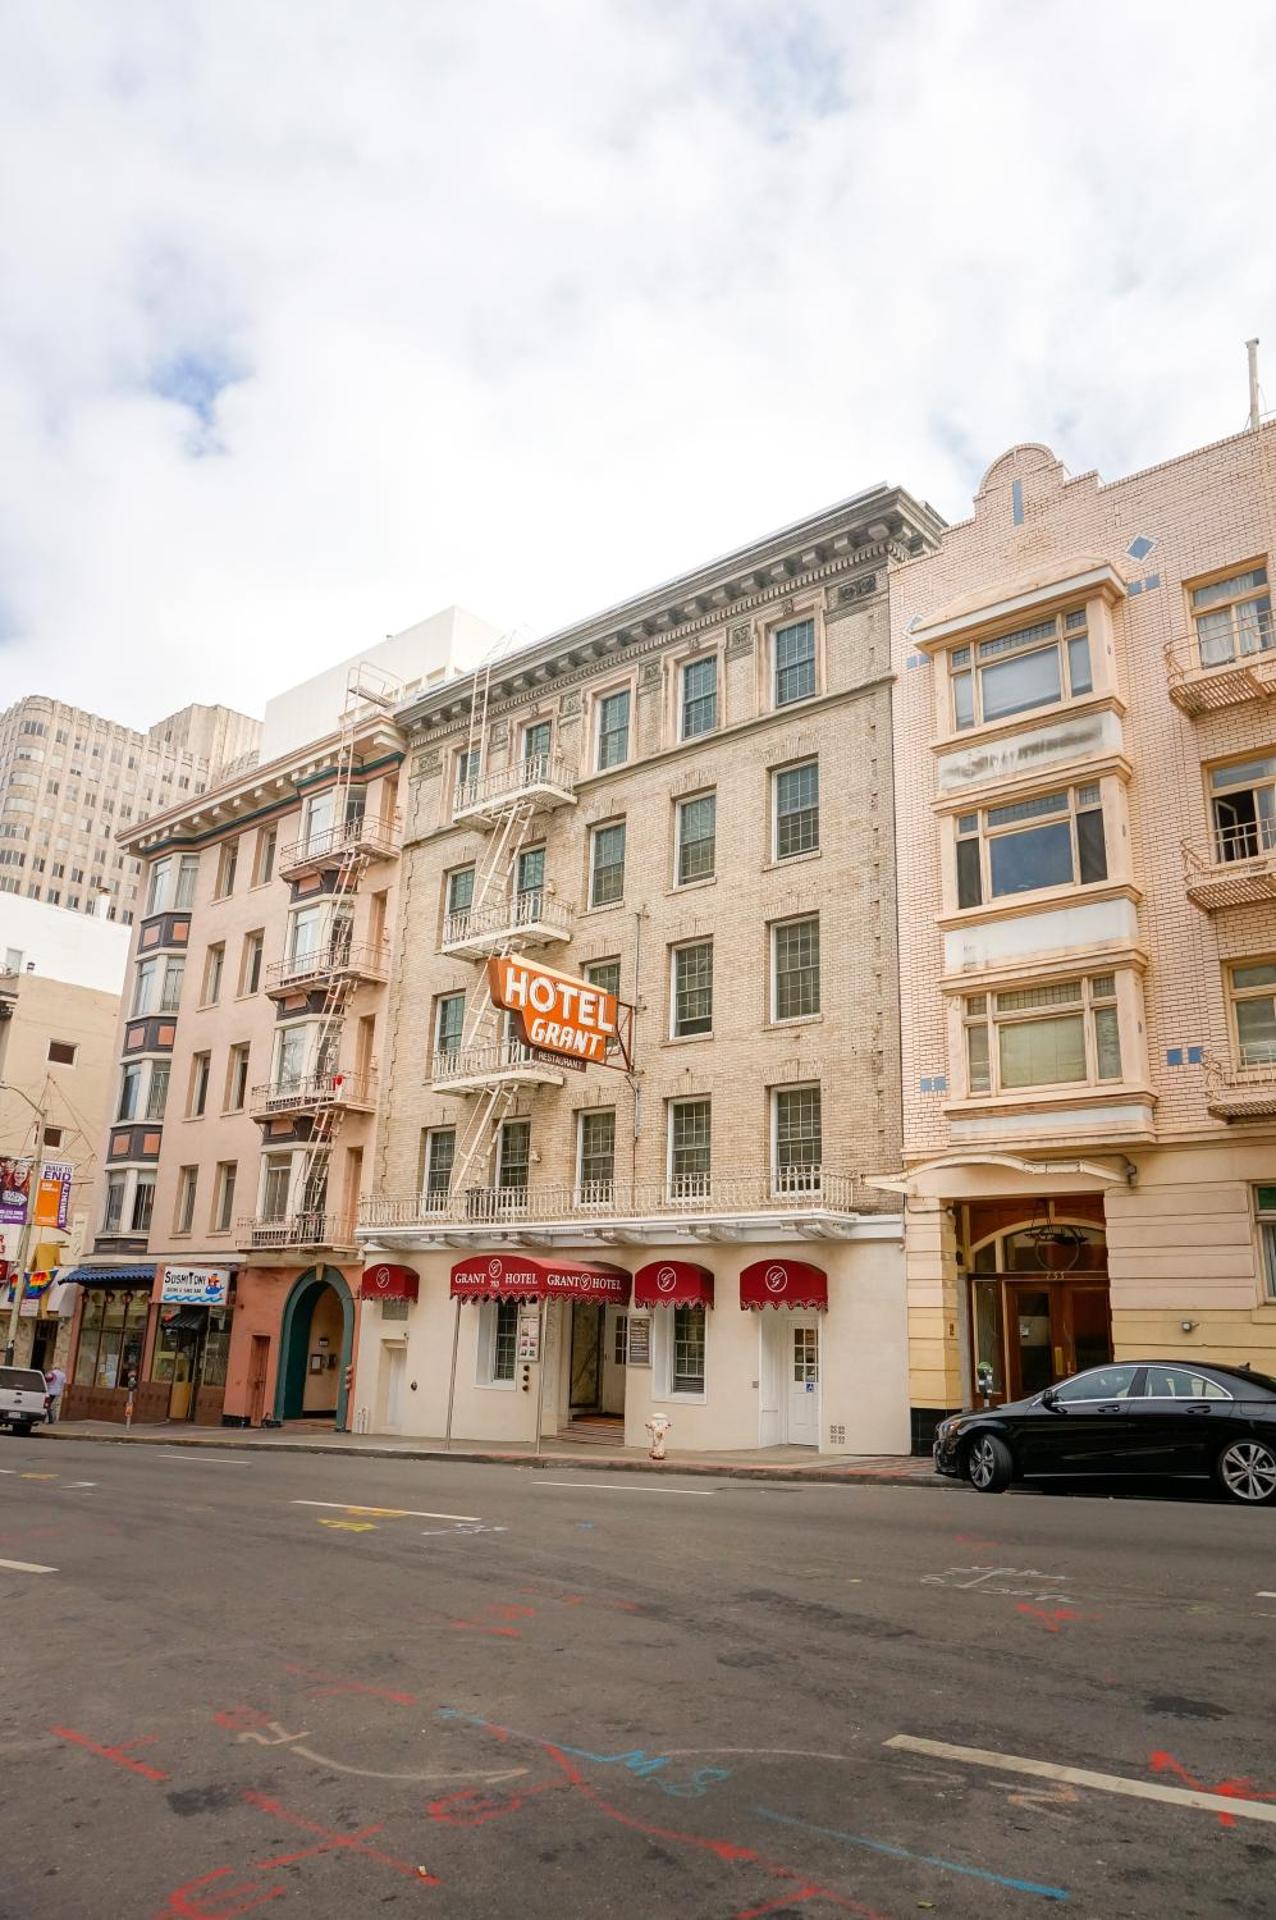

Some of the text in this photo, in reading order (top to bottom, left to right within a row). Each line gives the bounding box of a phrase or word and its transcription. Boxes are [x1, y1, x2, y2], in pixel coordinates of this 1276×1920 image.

[505, 967, 614, 1032] HOTEL
[530, 1018, 602, 1057] GRANT
[538, 1051, 584, 1069] RESTAURANT
[44, 1171, 72, 1181] END
[455, 1273, 538, 1285] GRANT HOTEL
[547, 1273, 580, 1286] GRANT
[592, 1278, 622, 1290] HOTEL
